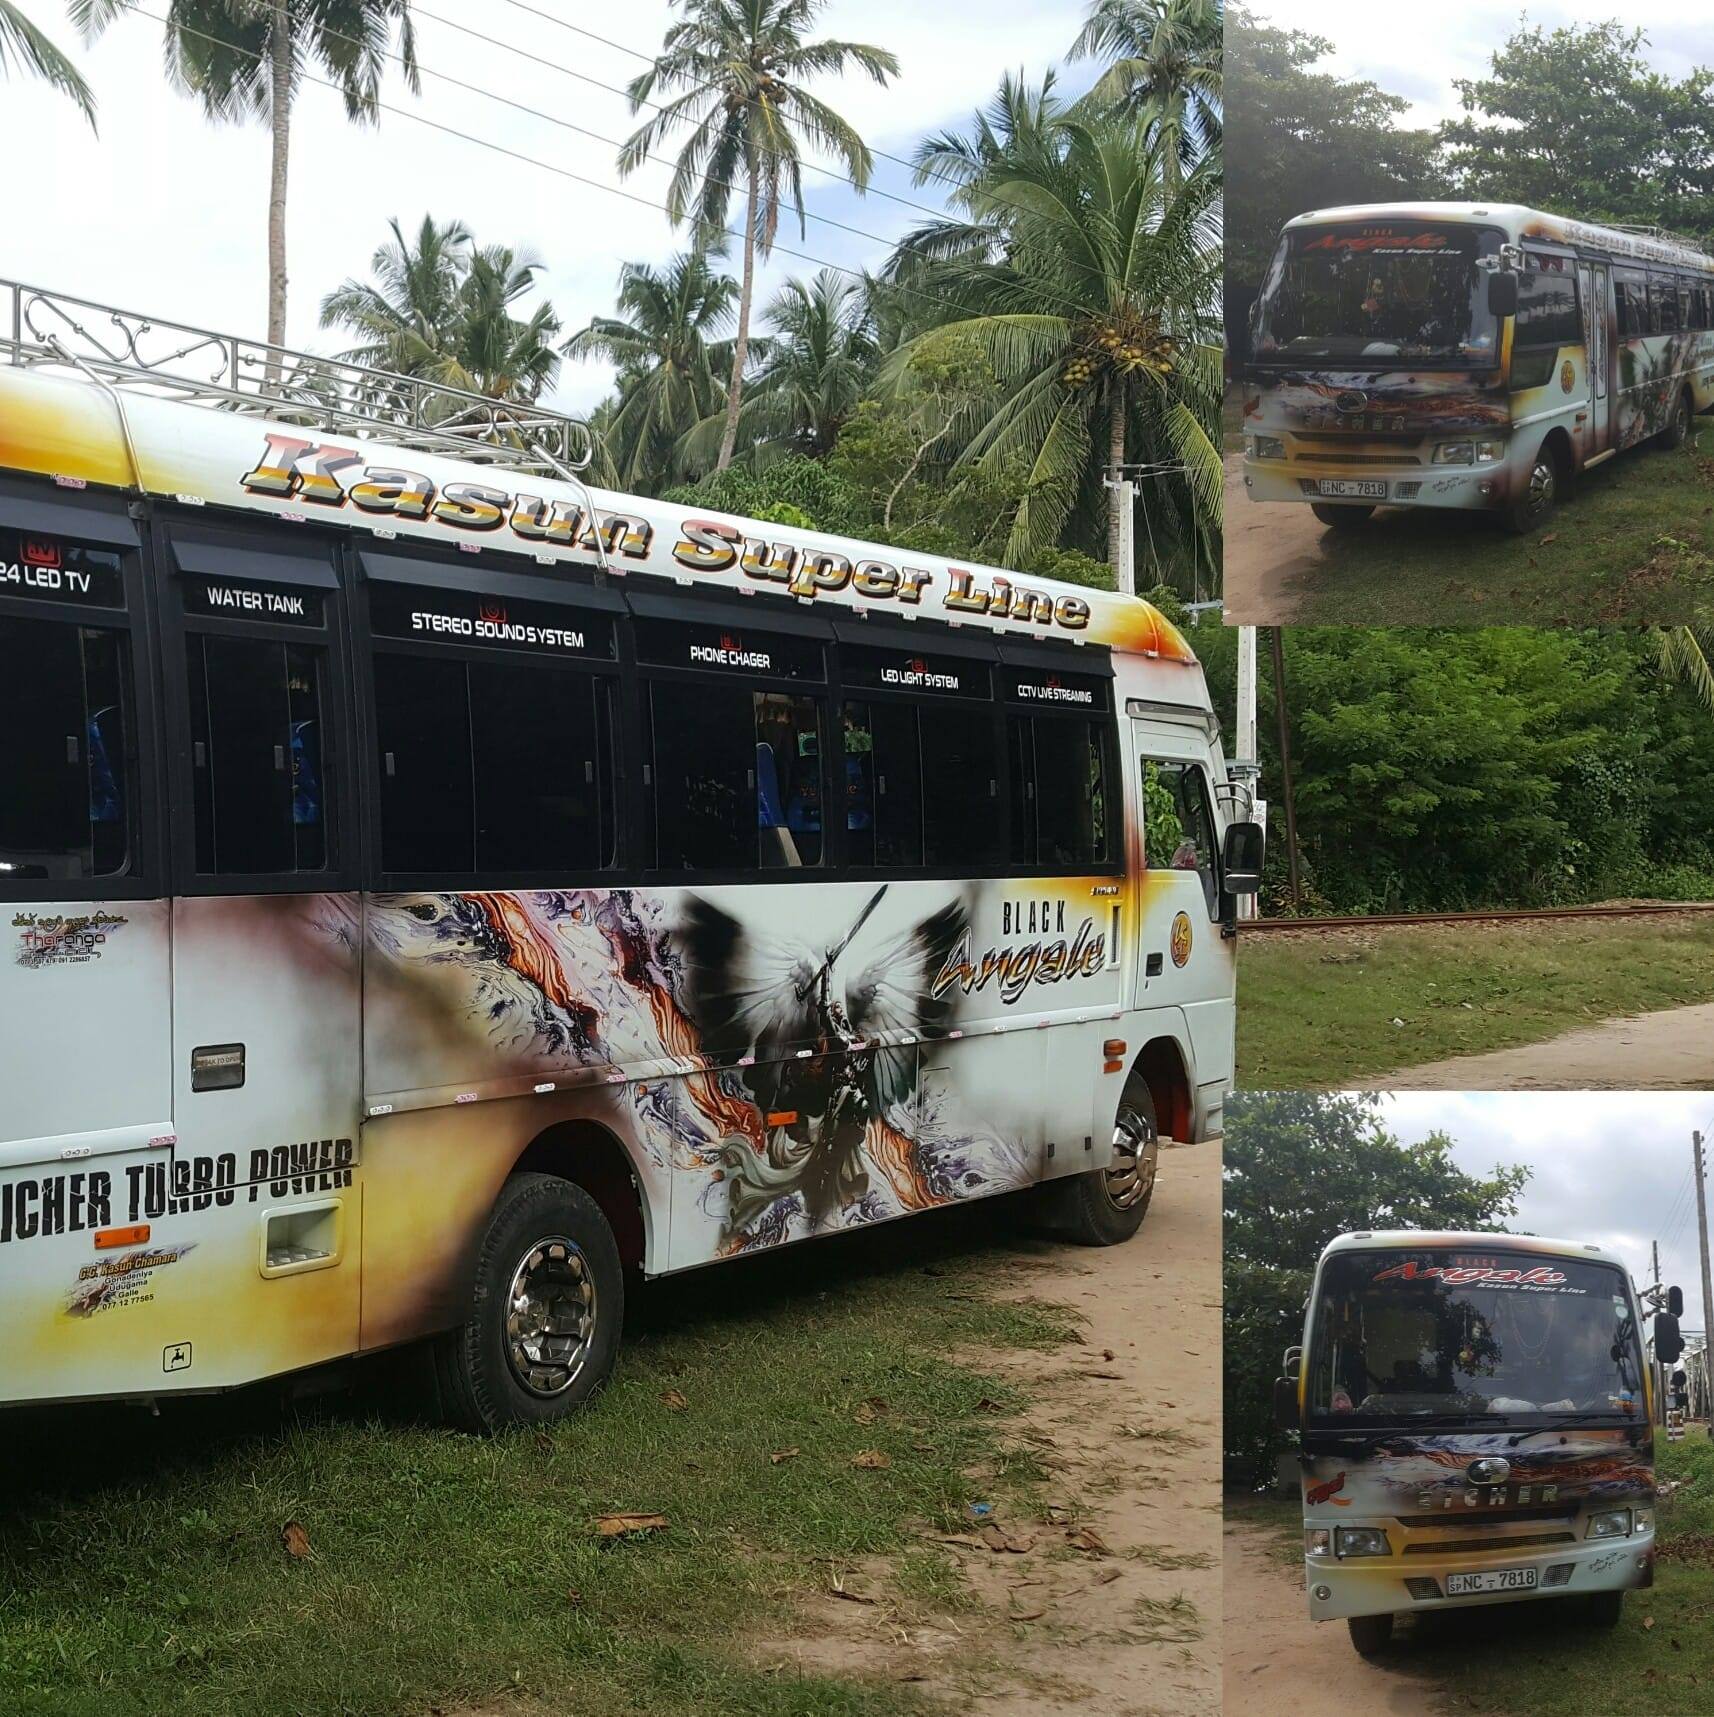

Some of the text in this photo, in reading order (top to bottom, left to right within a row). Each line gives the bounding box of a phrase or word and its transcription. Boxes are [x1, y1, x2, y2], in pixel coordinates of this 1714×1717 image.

[238, 433, 1091, 629] Kasun Super Line
[24, 565, 61, 589] LED
[65, 571, 91, 592] TV
[207, 587, 304, 615] WATER TANK
[412, 612, 584, 648] STEREO SOUND SYSTEM
[690, 646, 771, 669] PHONE CHAGER
[881, 668, 959, 690] LED LIGHT SYSTEM
[1017, 684, 1092, 703] CCTV LIVE STREAMING
[1003, 900, 1066, 936] BLACK
[931, 917, 1106, 1006] Angale
[0, 1138, 353, 1244] ICHER TURBO POWER
[100, 1259, 134, 1277] Kasun
[134, 1252, 178, 1270] Chamara
[109, 1280, 148, 1292] Udugama
[118, 1290, 139, 1299] Galle
[1521, 1284, 1556, 1292] Super
[102, 1300, 116, 1311] 077
[119, 1298, 129, 1307] 12
[1463, 1575, 1482, 1591] NC
[1499, 1570, 1534, 1587] 7818
